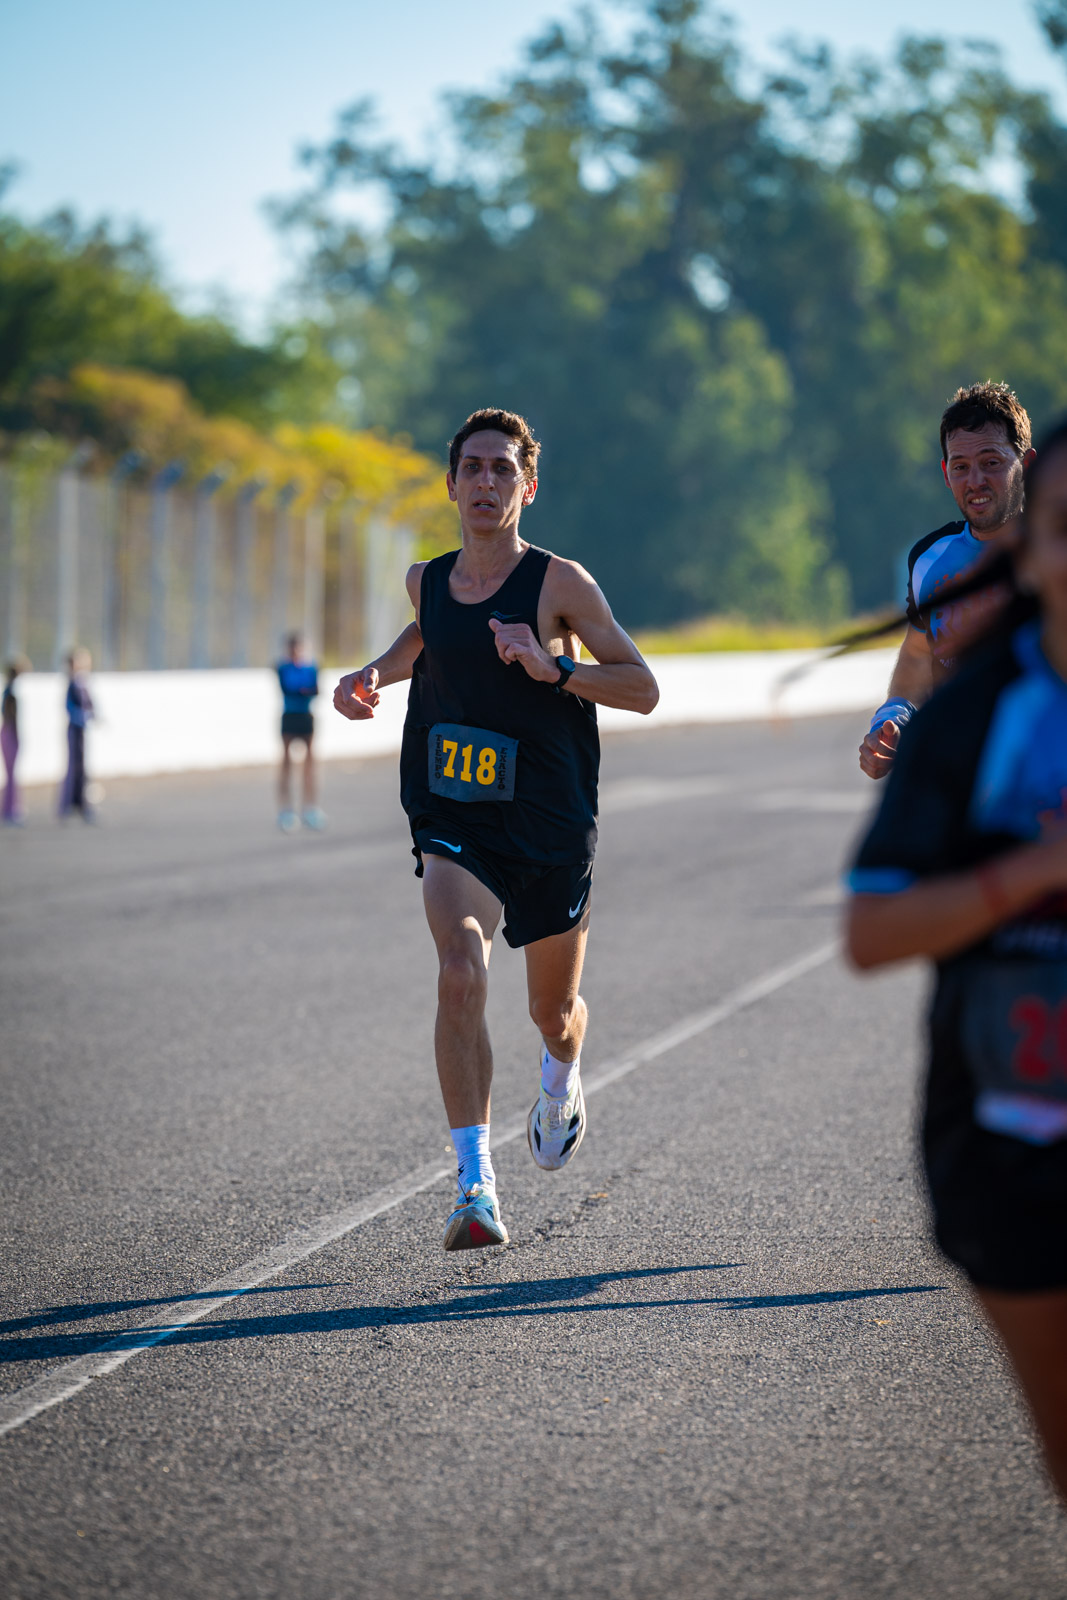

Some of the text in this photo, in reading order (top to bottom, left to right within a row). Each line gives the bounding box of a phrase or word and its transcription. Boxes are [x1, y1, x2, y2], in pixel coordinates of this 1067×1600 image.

[434, 734, 442, 779] TIEMPO
[443, 739, 497, 785] 718
[497, 747, 508, 790] EXACTO
[1009, 995, 1067, 1082] 2
